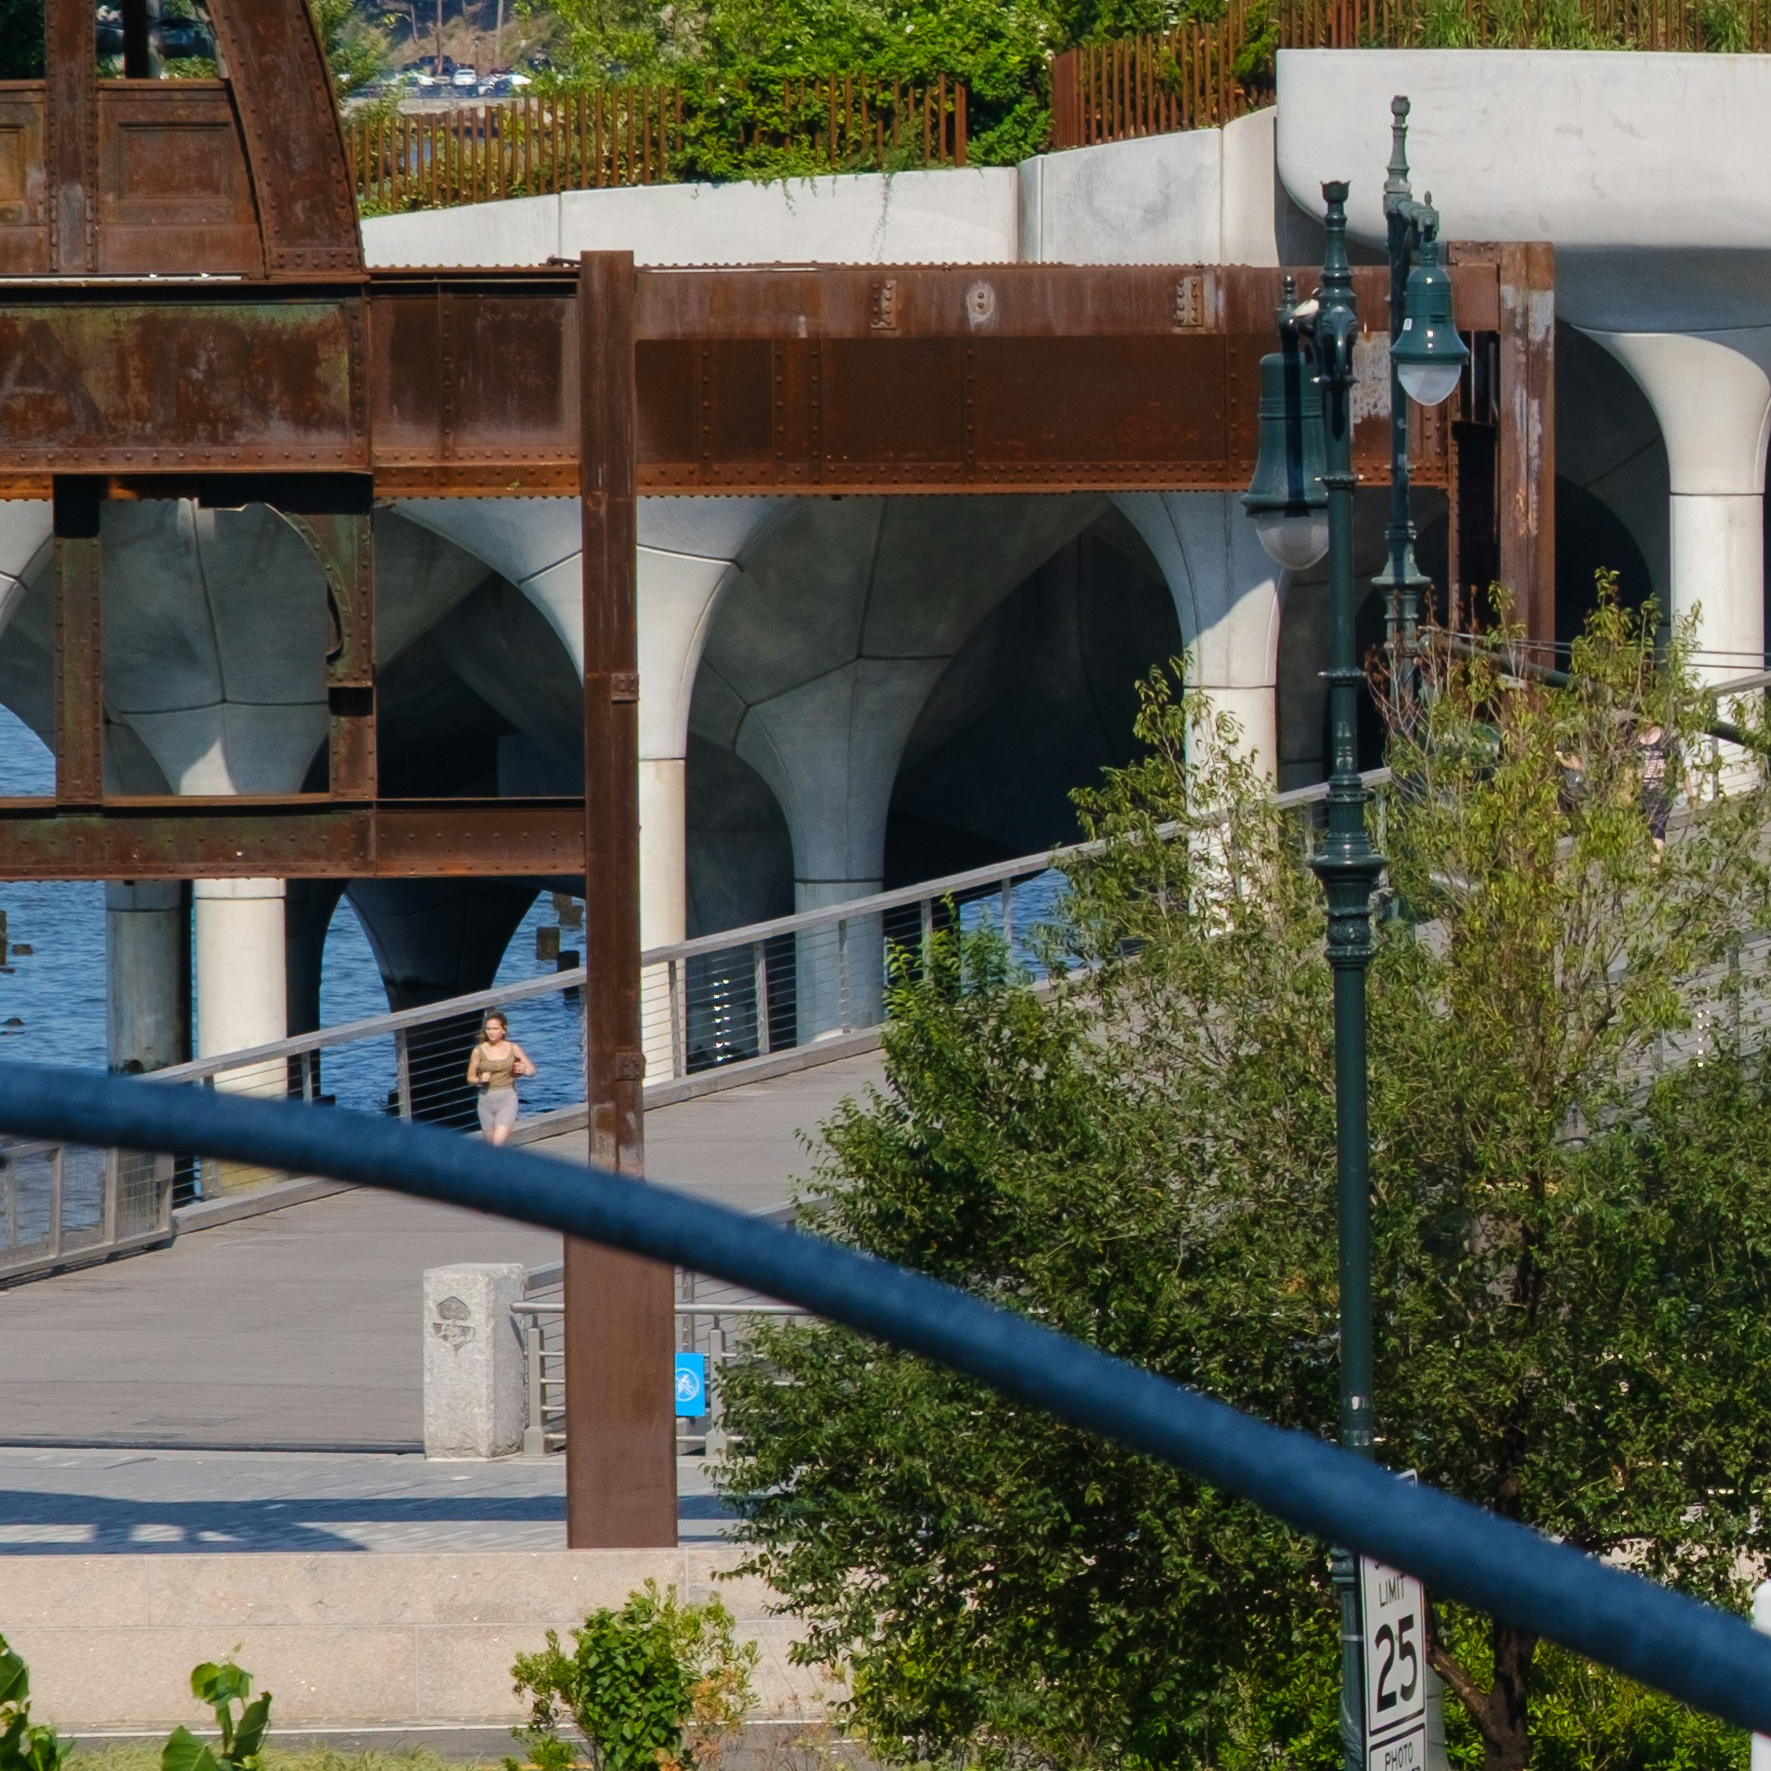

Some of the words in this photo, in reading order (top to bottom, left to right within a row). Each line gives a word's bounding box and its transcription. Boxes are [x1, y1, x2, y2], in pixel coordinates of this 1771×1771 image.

[1378, 1574, 1405, 1607] LIMIT
[1374, 1614, 1418, 1713] 25
[1385, 1741, 1414, 1771] PHOTO
